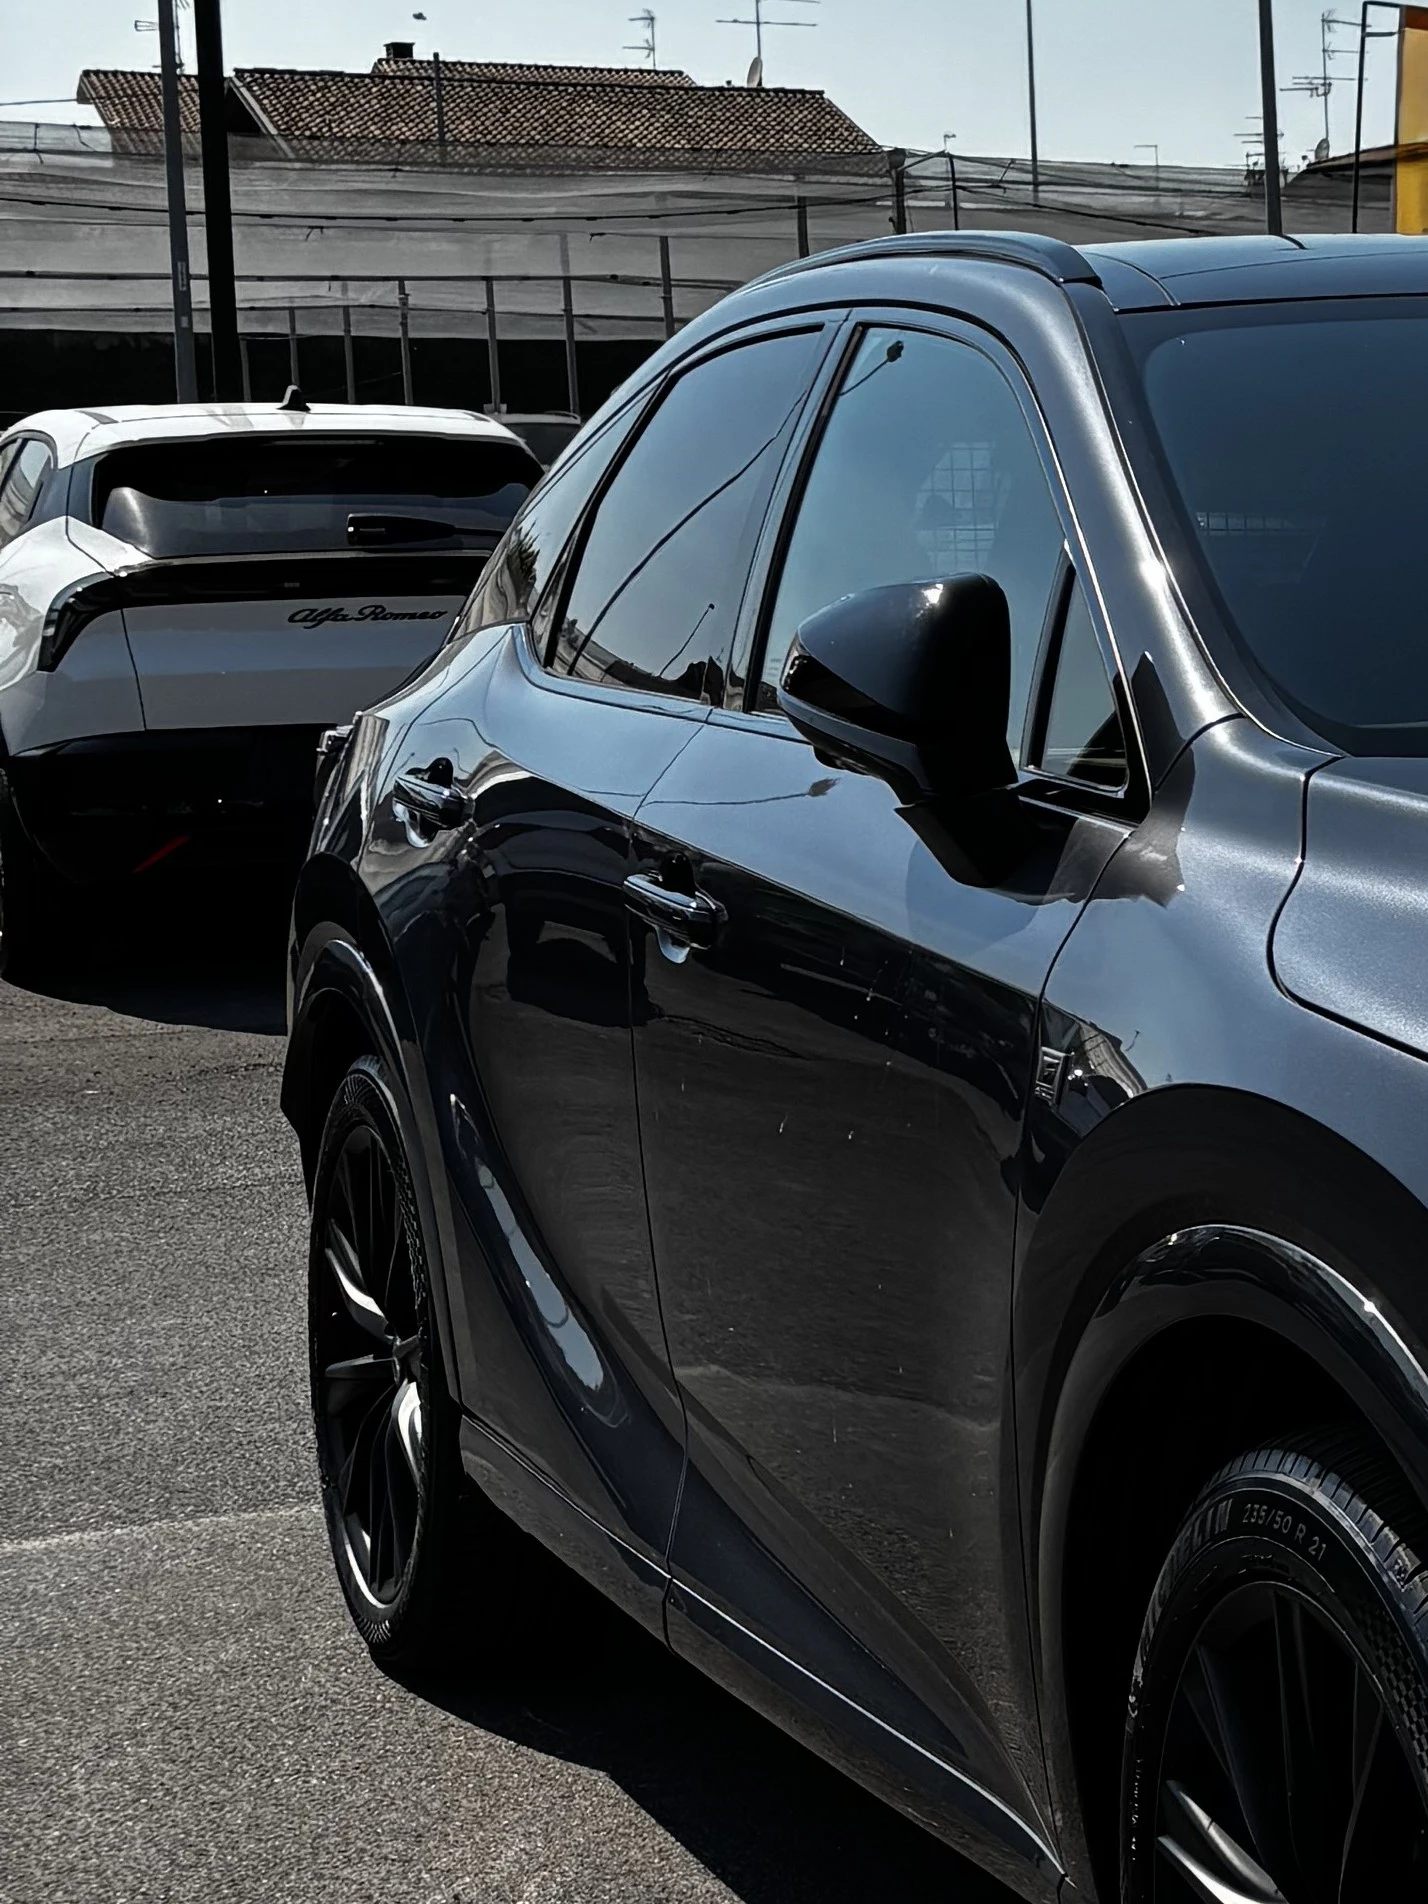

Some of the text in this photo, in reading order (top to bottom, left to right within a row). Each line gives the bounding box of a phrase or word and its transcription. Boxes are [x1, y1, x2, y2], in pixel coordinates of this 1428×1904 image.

[287, 604, 448, 630] Alfa Romeo
[1241, 1502, 1293, 1535] 235/50
[1293, 1524, 1307, 1546] R
[1307, 1536, 1328, 1562] 21
